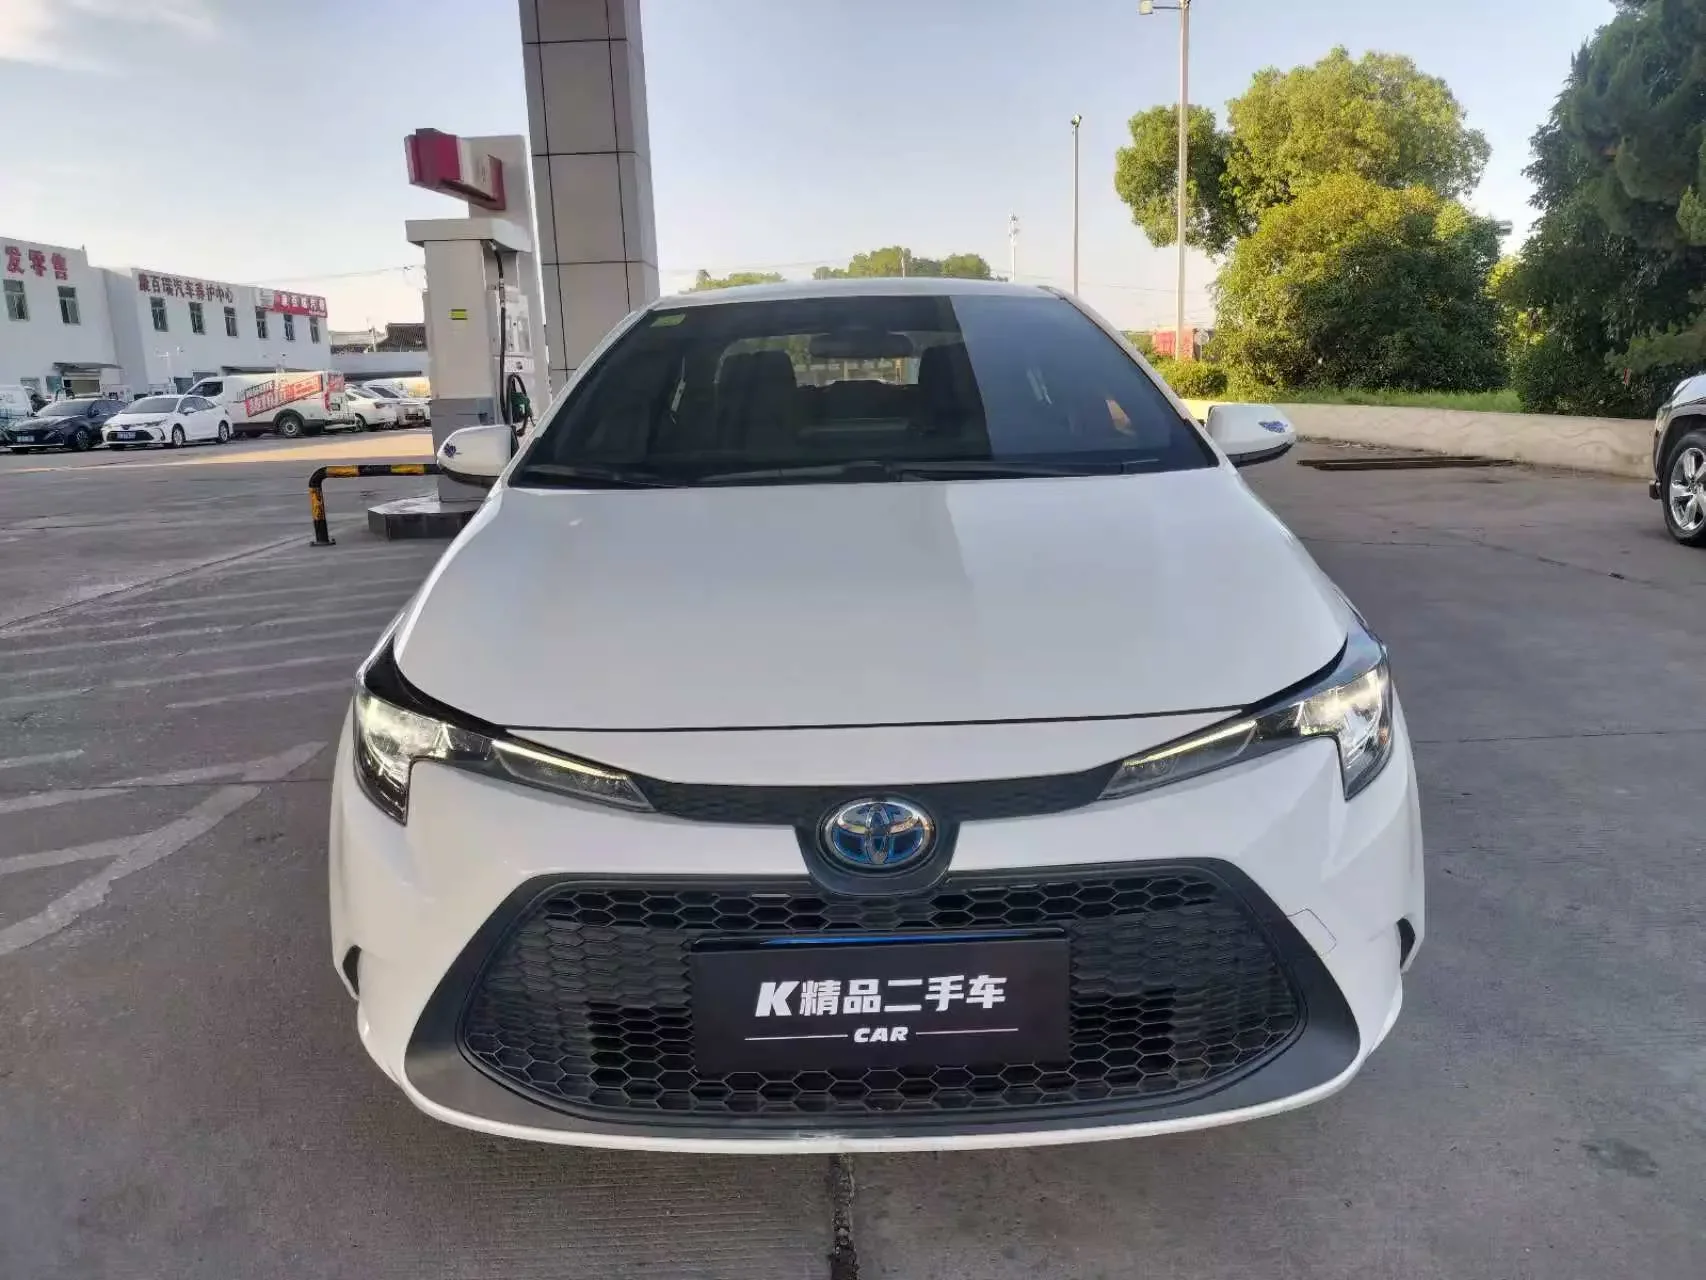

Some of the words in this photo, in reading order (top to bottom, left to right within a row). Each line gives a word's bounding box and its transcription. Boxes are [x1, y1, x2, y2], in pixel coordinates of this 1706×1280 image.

[755, 975, 1007, 1017] K精品二手车
[853, 1026, 908, 1043] CAR
